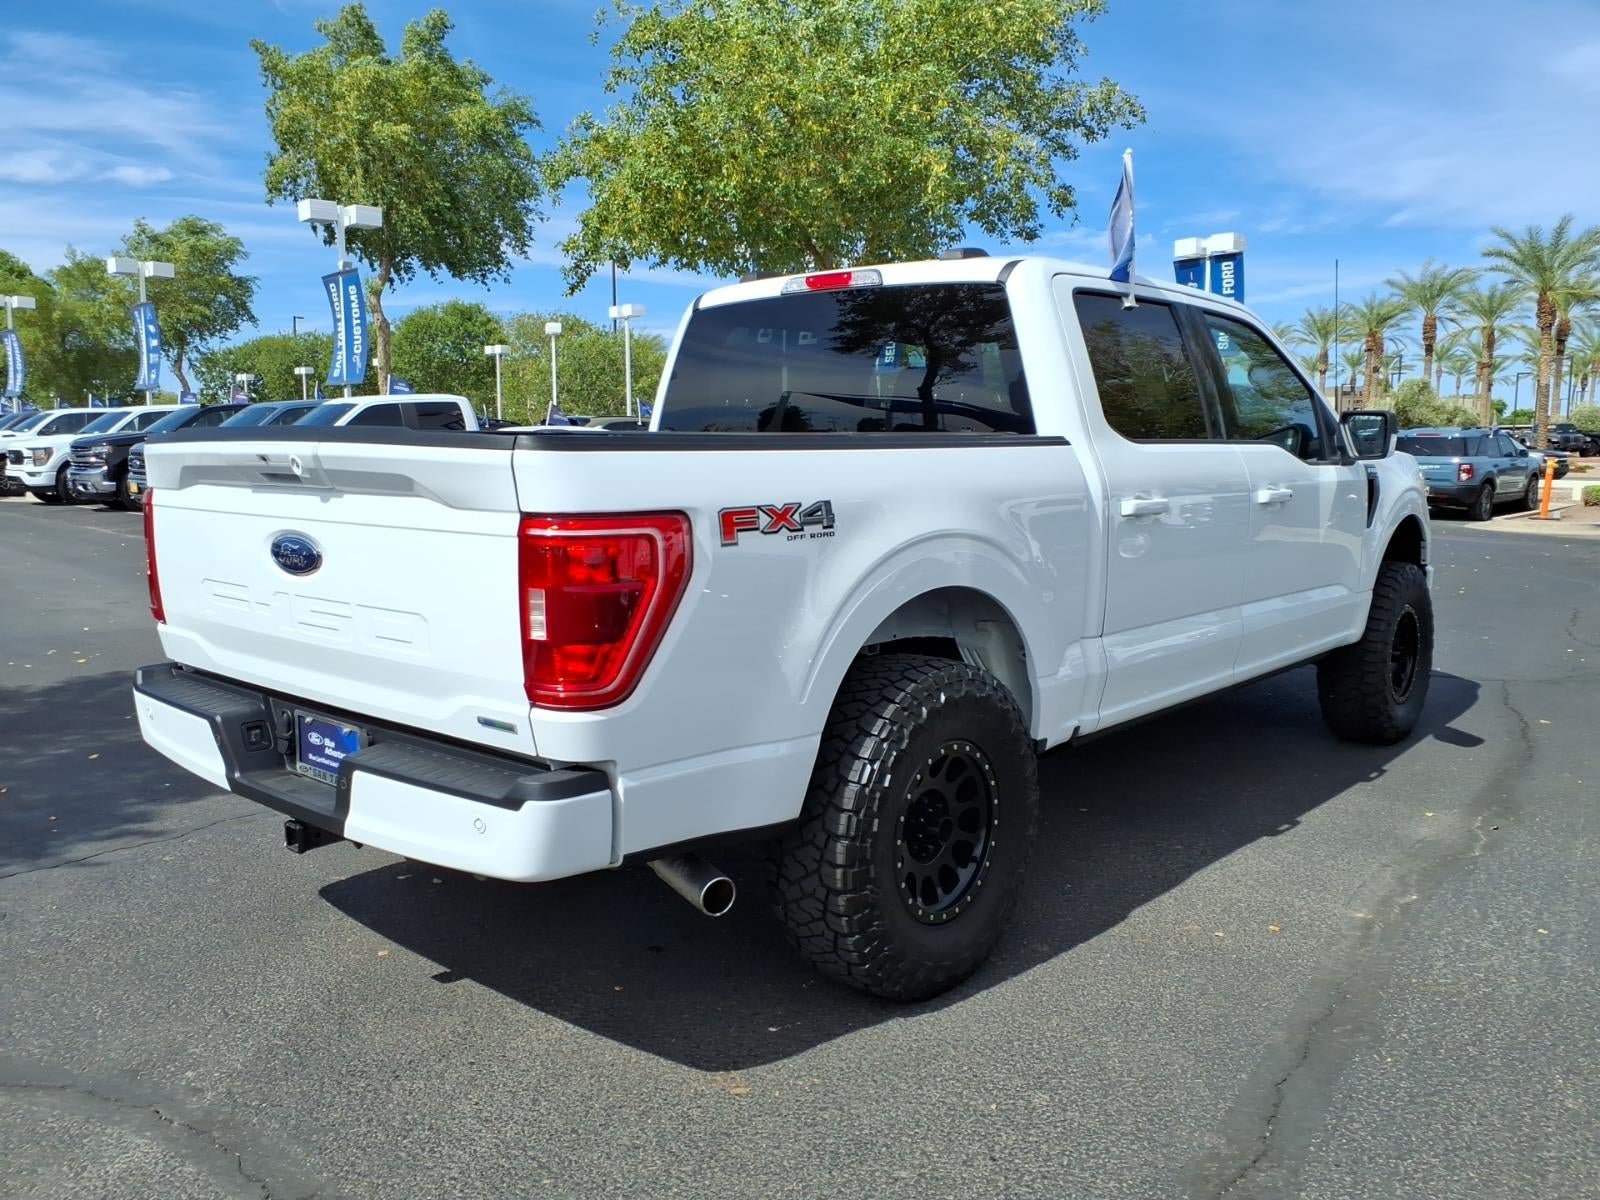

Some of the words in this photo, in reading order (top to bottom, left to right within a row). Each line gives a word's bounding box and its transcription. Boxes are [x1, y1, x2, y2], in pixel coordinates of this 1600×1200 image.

[1221, 261, 1235, 295] FORD
[329, 283, 342, 319] FORD
[348, 284, 362, 354] CUSTOMS
[333, 351, 343, 378] SAN
[718, 499, 835, 547] FX4
[787, 533, 807, 542] OFF
[810, 530, 835, 540] ROAD
